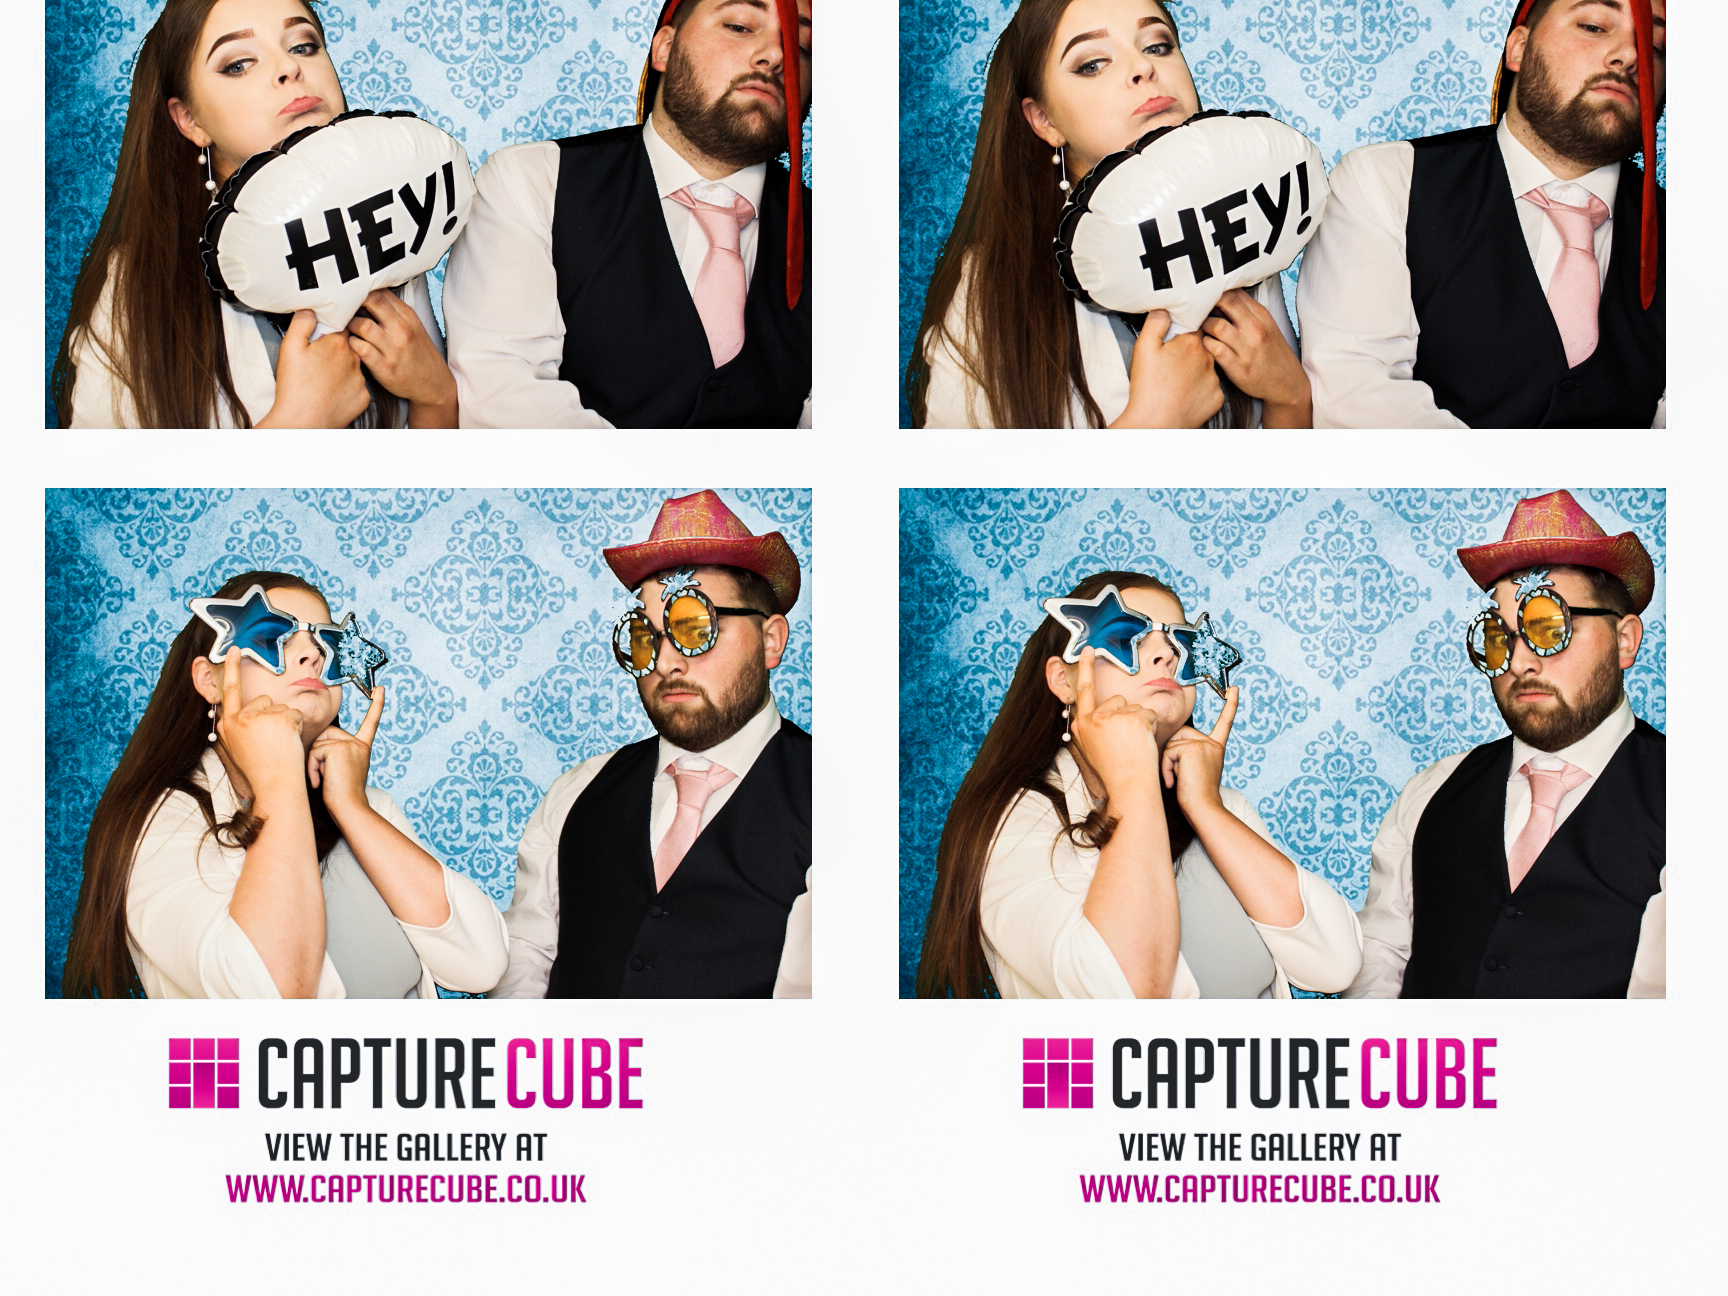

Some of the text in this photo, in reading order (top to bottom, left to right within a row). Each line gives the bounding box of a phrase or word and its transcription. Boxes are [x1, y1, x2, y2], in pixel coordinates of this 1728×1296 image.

[284, 160, 458, 291] HEY!
[1138, 160, 1312, 291] HEY!
[264, 1133, 548, 1162] VIEW THE GALLERY AT
[1118, 1133, 1402, 1162] VIEW THE GALLERY AT
[225, 1174, 587, 1203] WWW.CAPTURECUBE.CO.UK
[1079, 1174, 1441, 1203] WWW.CAPTURECUBE.CO.UK
